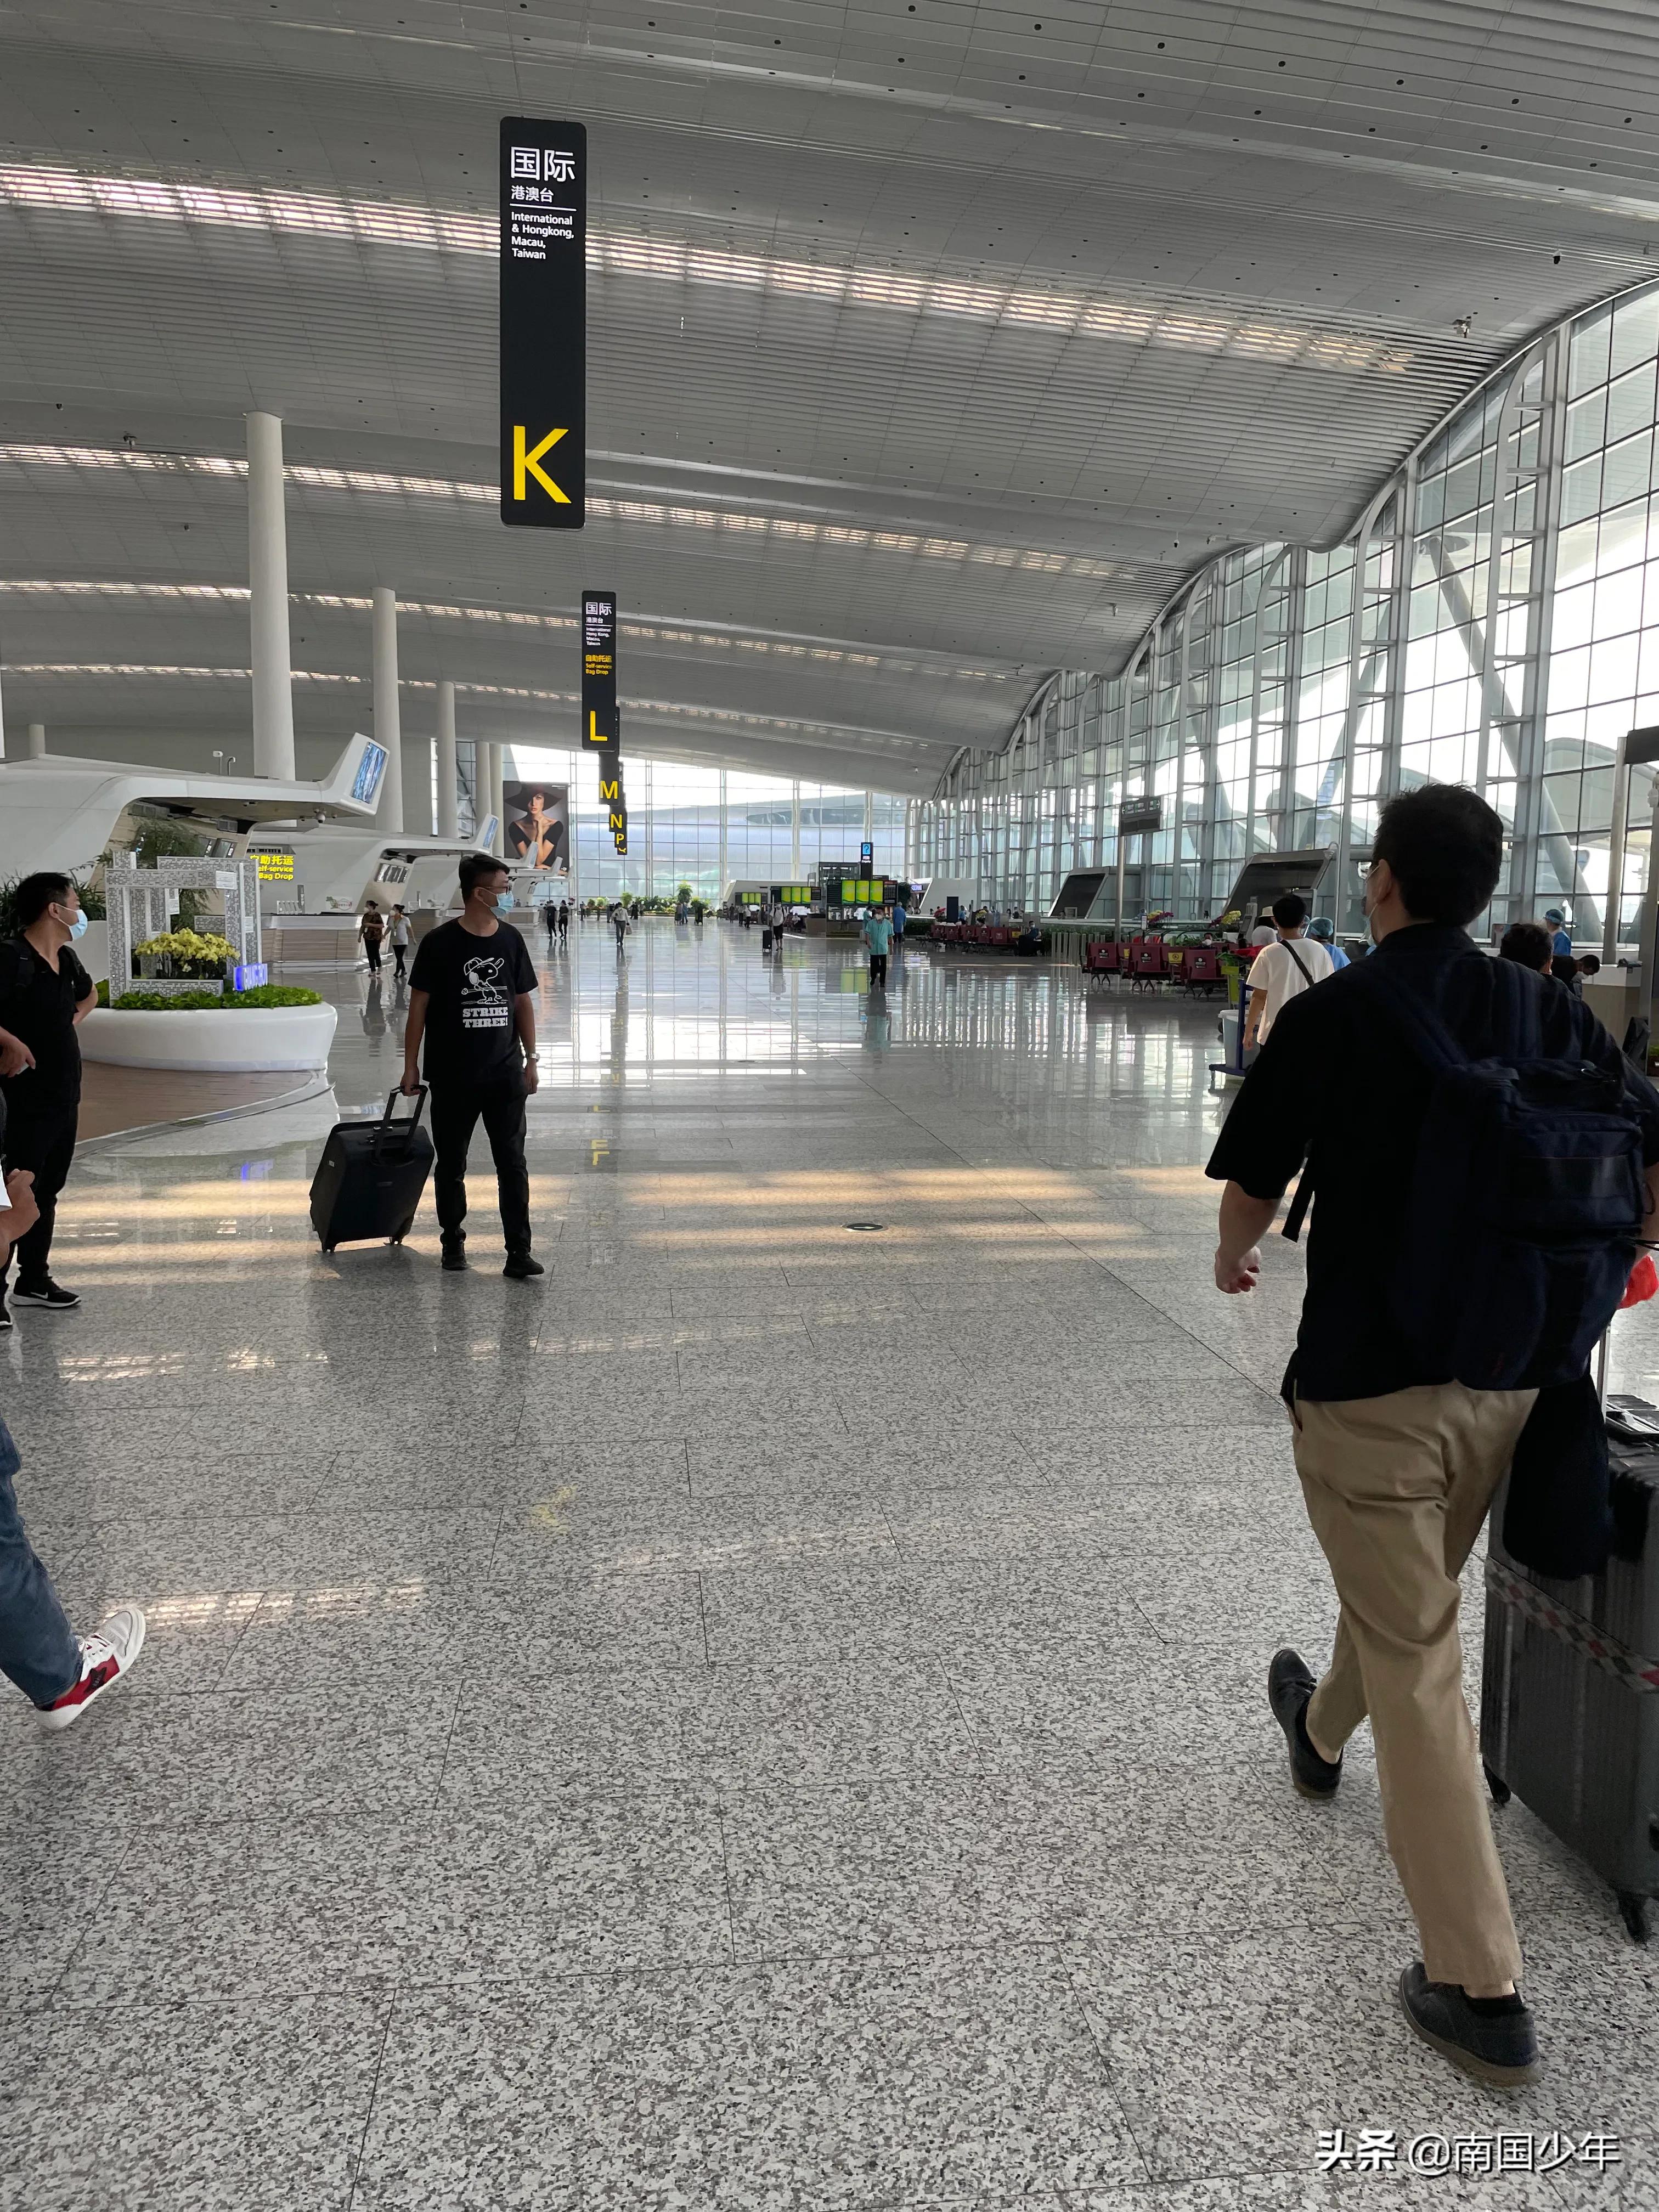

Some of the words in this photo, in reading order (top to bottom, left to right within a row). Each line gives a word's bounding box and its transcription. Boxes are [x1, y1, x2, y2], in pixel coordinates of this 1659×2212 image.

[511, 146, 575, 182] 国际
[511, 185, 554, 203] 港澳台
[511, 212, 573, 225] International
[511, 224, 520, 233] &
[522, 225, 574, 239] Hongkong,
[511, 236, 546, 249] Macau,
[512, 248, 546, 259] Taiwan
[514, 425, 572, 504] K
[585, 602, 612, 615] 国际
[590, 710, 608, 741] L
[600, 780, 618, 799] M
[611, 814, 623, 829] N
[616, 833, 625, 845] P
[258, 872, 273, 881] Bag
[274, 873, 294, 881] Drop
[462, 1007, 508, 1017] STRIKE
[462, 1017, 508, 1028] THREE!
